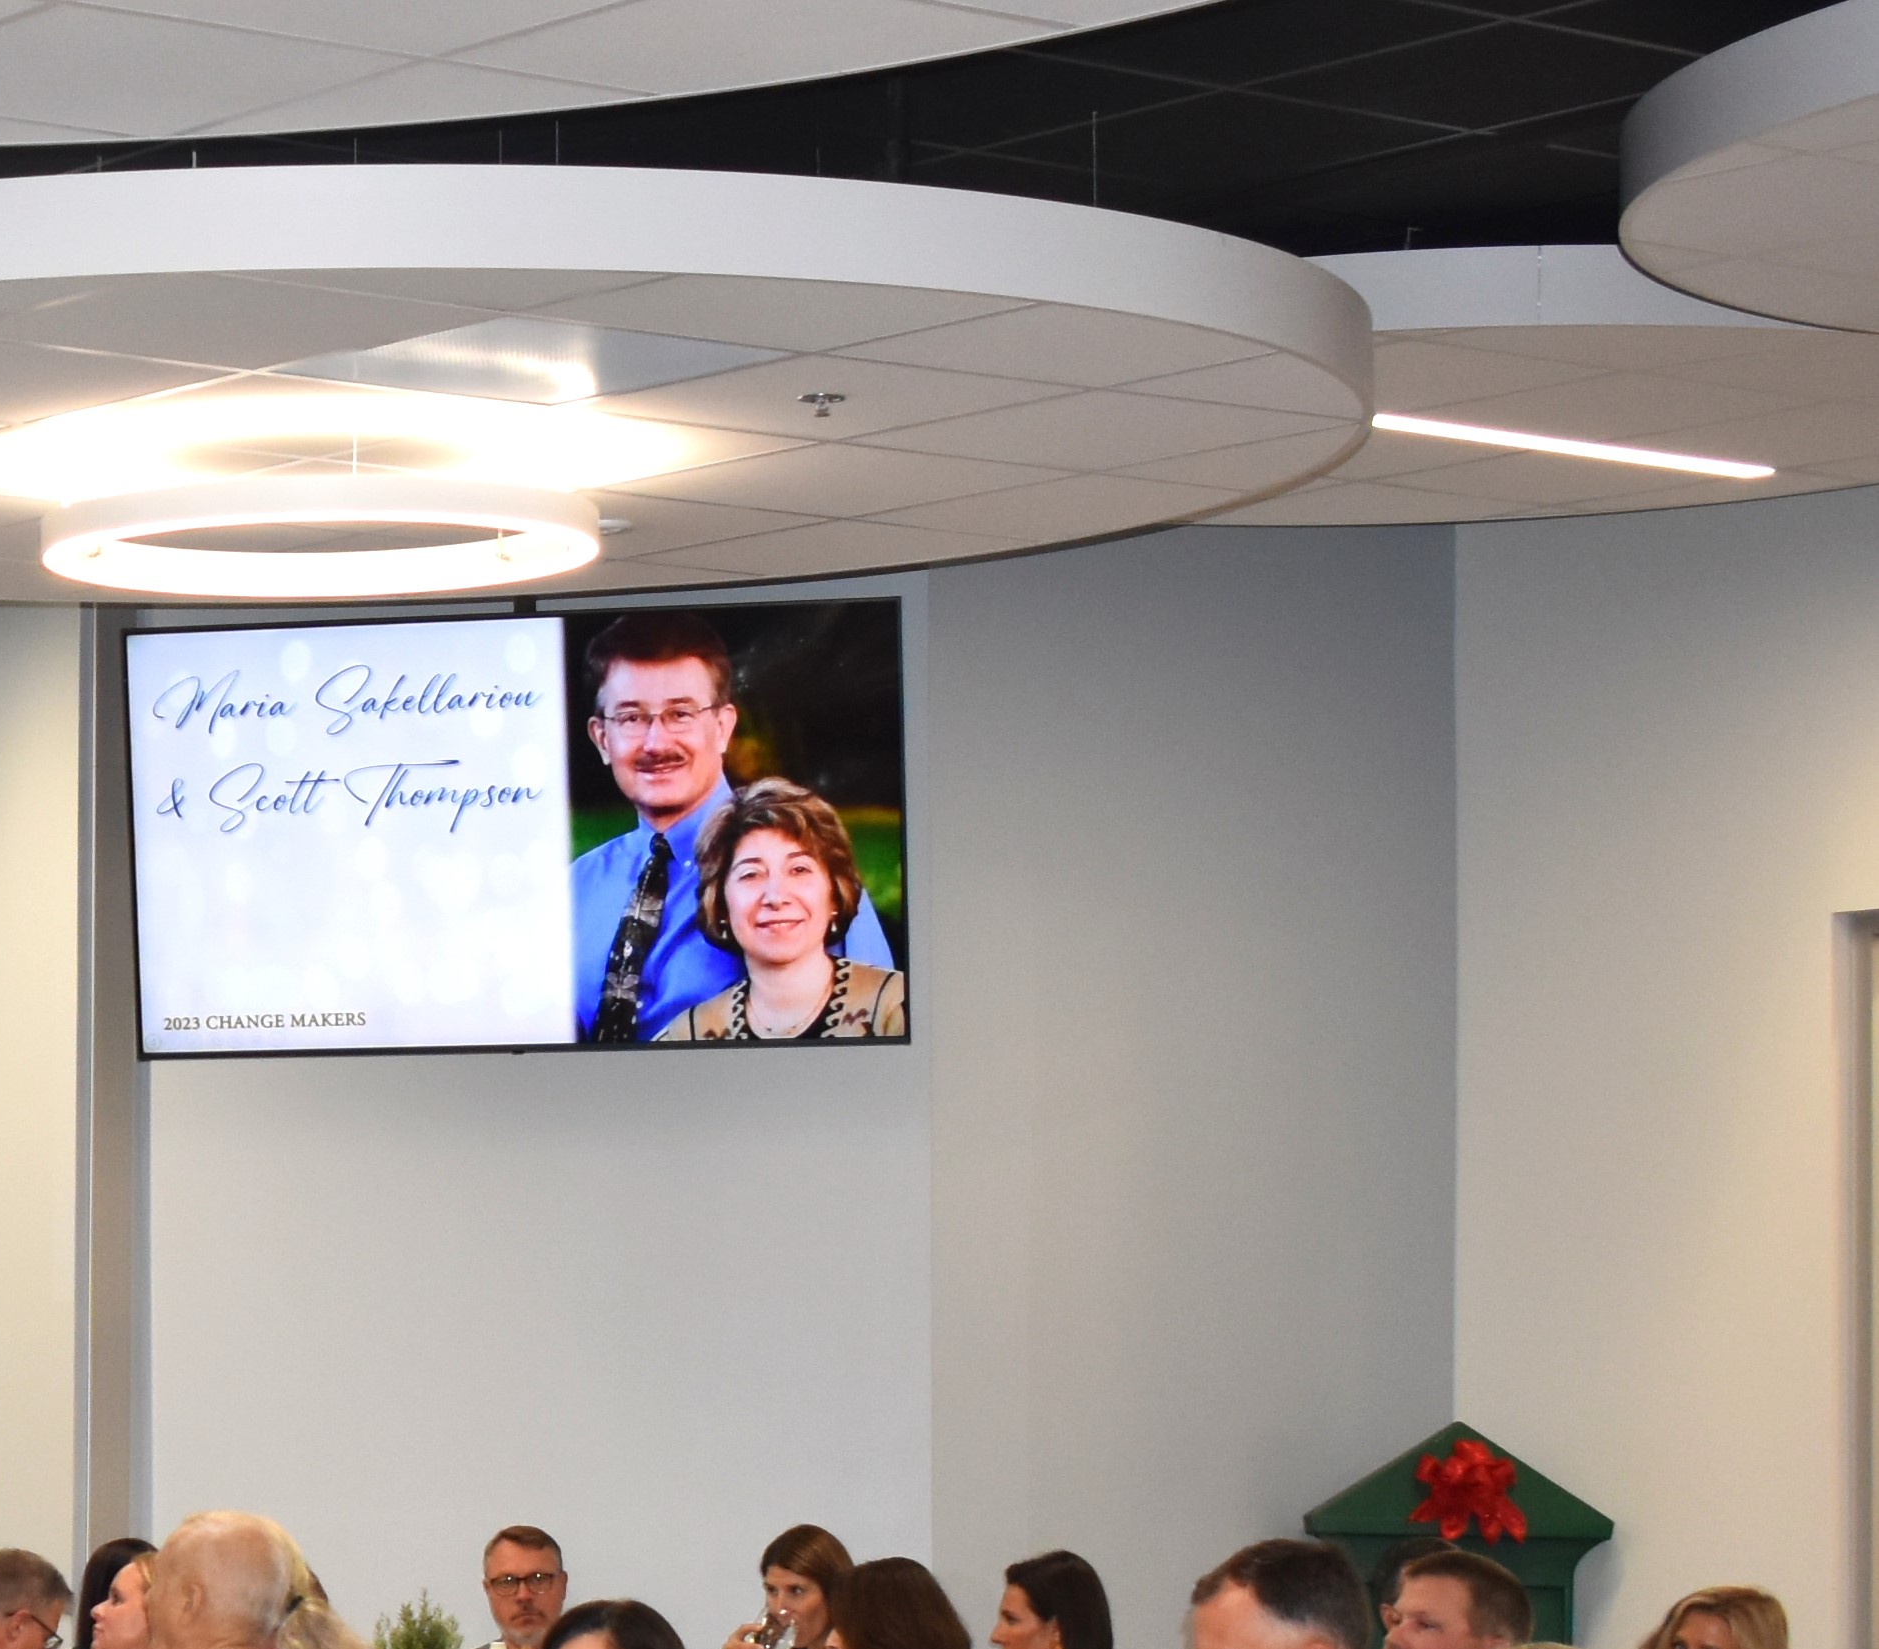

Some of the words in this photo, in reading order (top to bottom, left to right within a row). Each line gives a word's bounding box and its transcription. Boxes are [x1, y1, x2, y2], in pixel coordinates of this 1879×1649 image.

[153, 670, 295, 734] Maria
[315, 664, 541, 736] Sakellariou
[156, 778, 184, 818] &
[209, 763, 340, 832] Scott
[343, 759, 542, 833] Thompson
[164, 1017, 200, 1031] 2023
[206, 1014, 285, 1030] CHANGE
[291, 1011, 366, 1028] MAKERS
